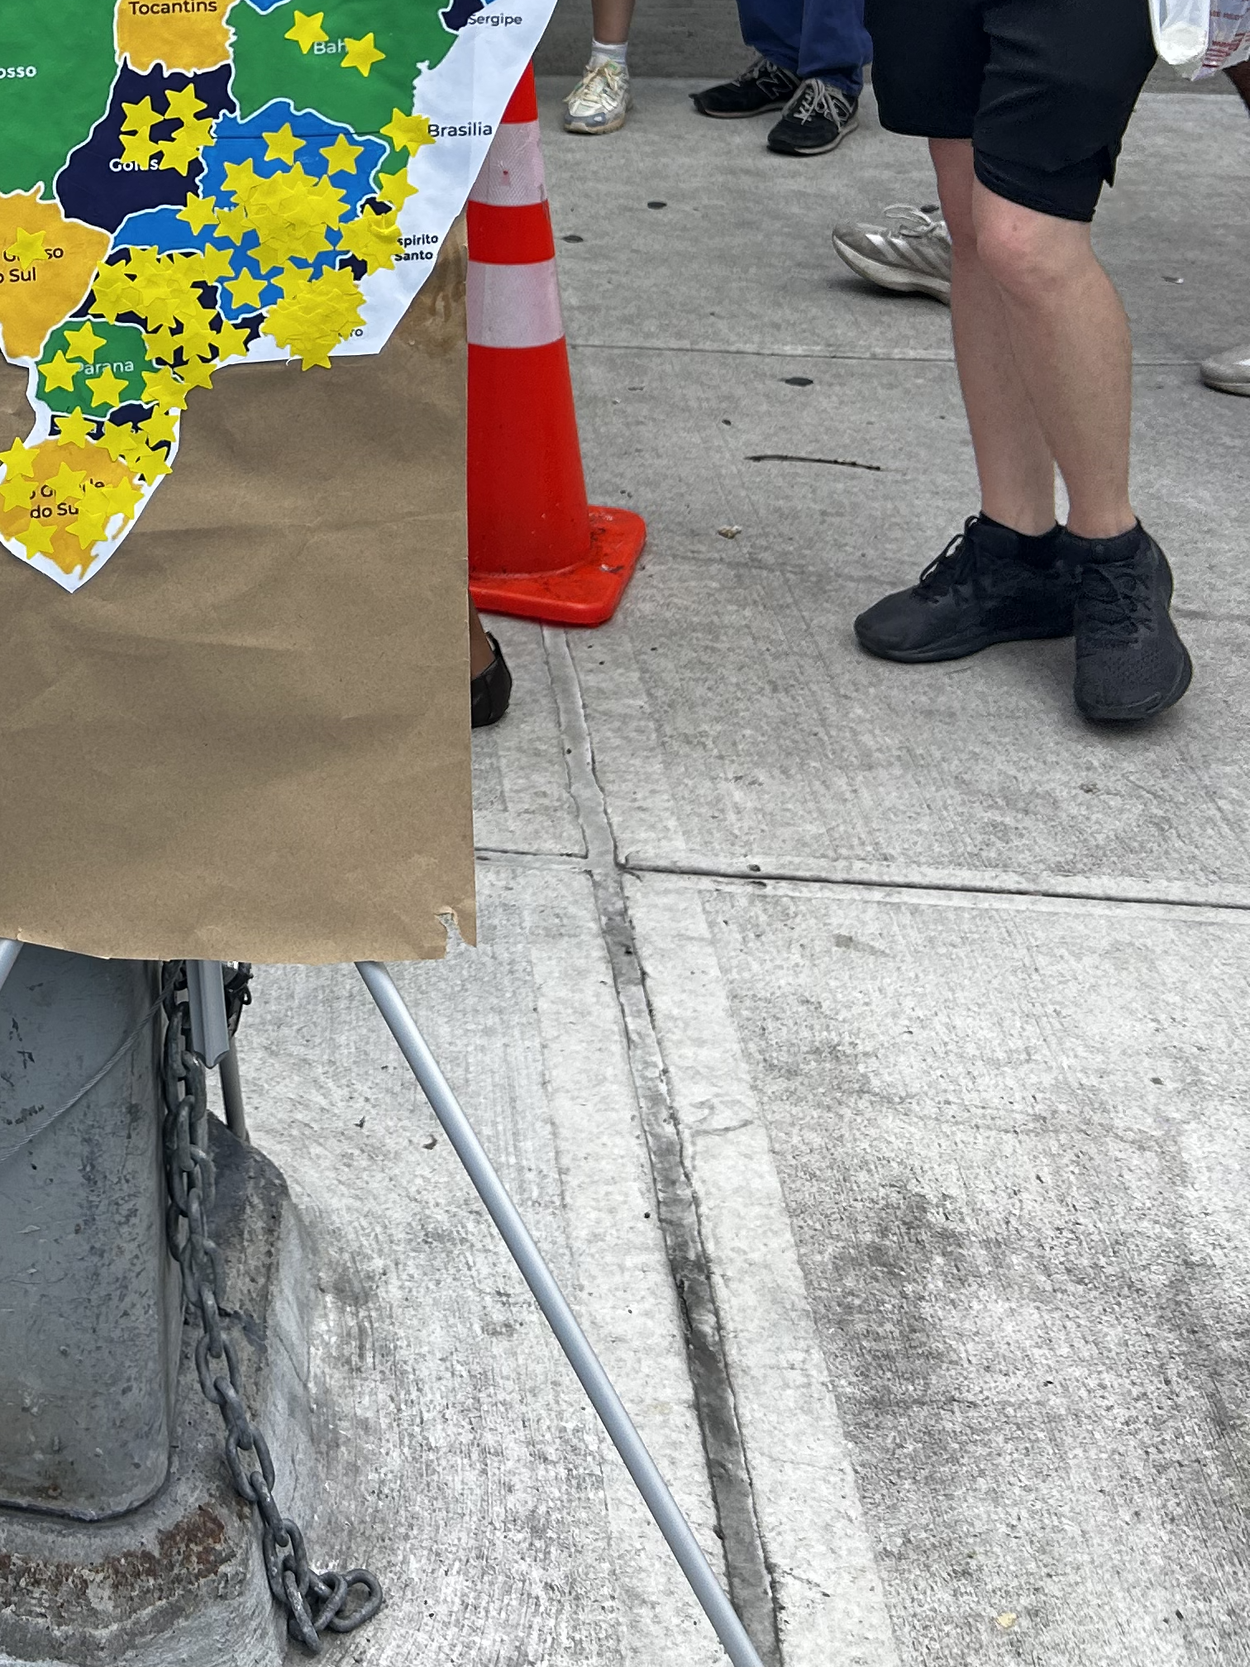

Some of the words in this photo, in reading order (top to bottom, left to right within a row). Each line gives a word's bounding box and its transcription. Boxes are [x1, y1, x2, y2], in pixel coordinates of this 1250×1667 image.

[468, 14, 523, 27] Sergipe
[313, 39, 348, 55] Bah
[428, 122, 493, 138] Brasilia
[109, 158, 159, 172] Gois
[396, 234, 439, 249] spirito
[9, 266, 37, 283] Sul
[30, 504, 53, 519] do
[56, 502, 80, 516] Su
